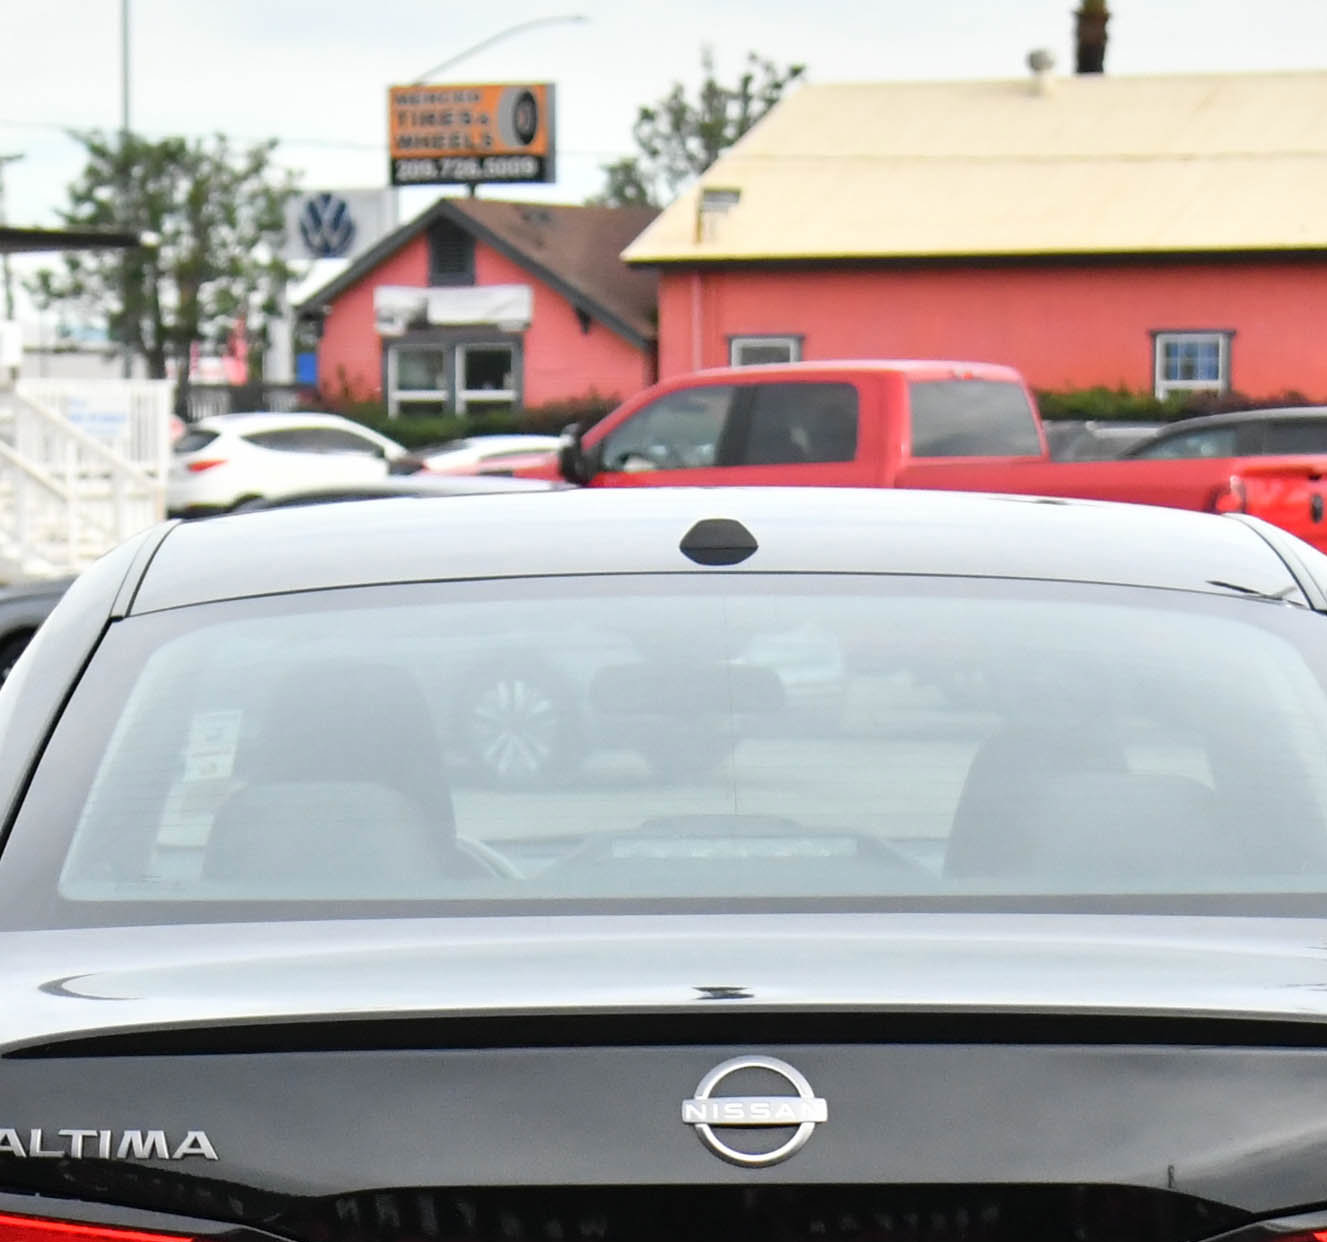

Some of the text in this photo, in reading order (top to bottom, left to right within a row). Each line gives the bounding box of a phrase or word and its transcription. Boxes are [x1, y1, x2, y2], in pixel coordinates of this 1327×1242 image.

[396, 110, 471, 127] TIRES
[396, 133, 493, 150] WHEELS
[684, 1101, 820, 1122] NISSAN
